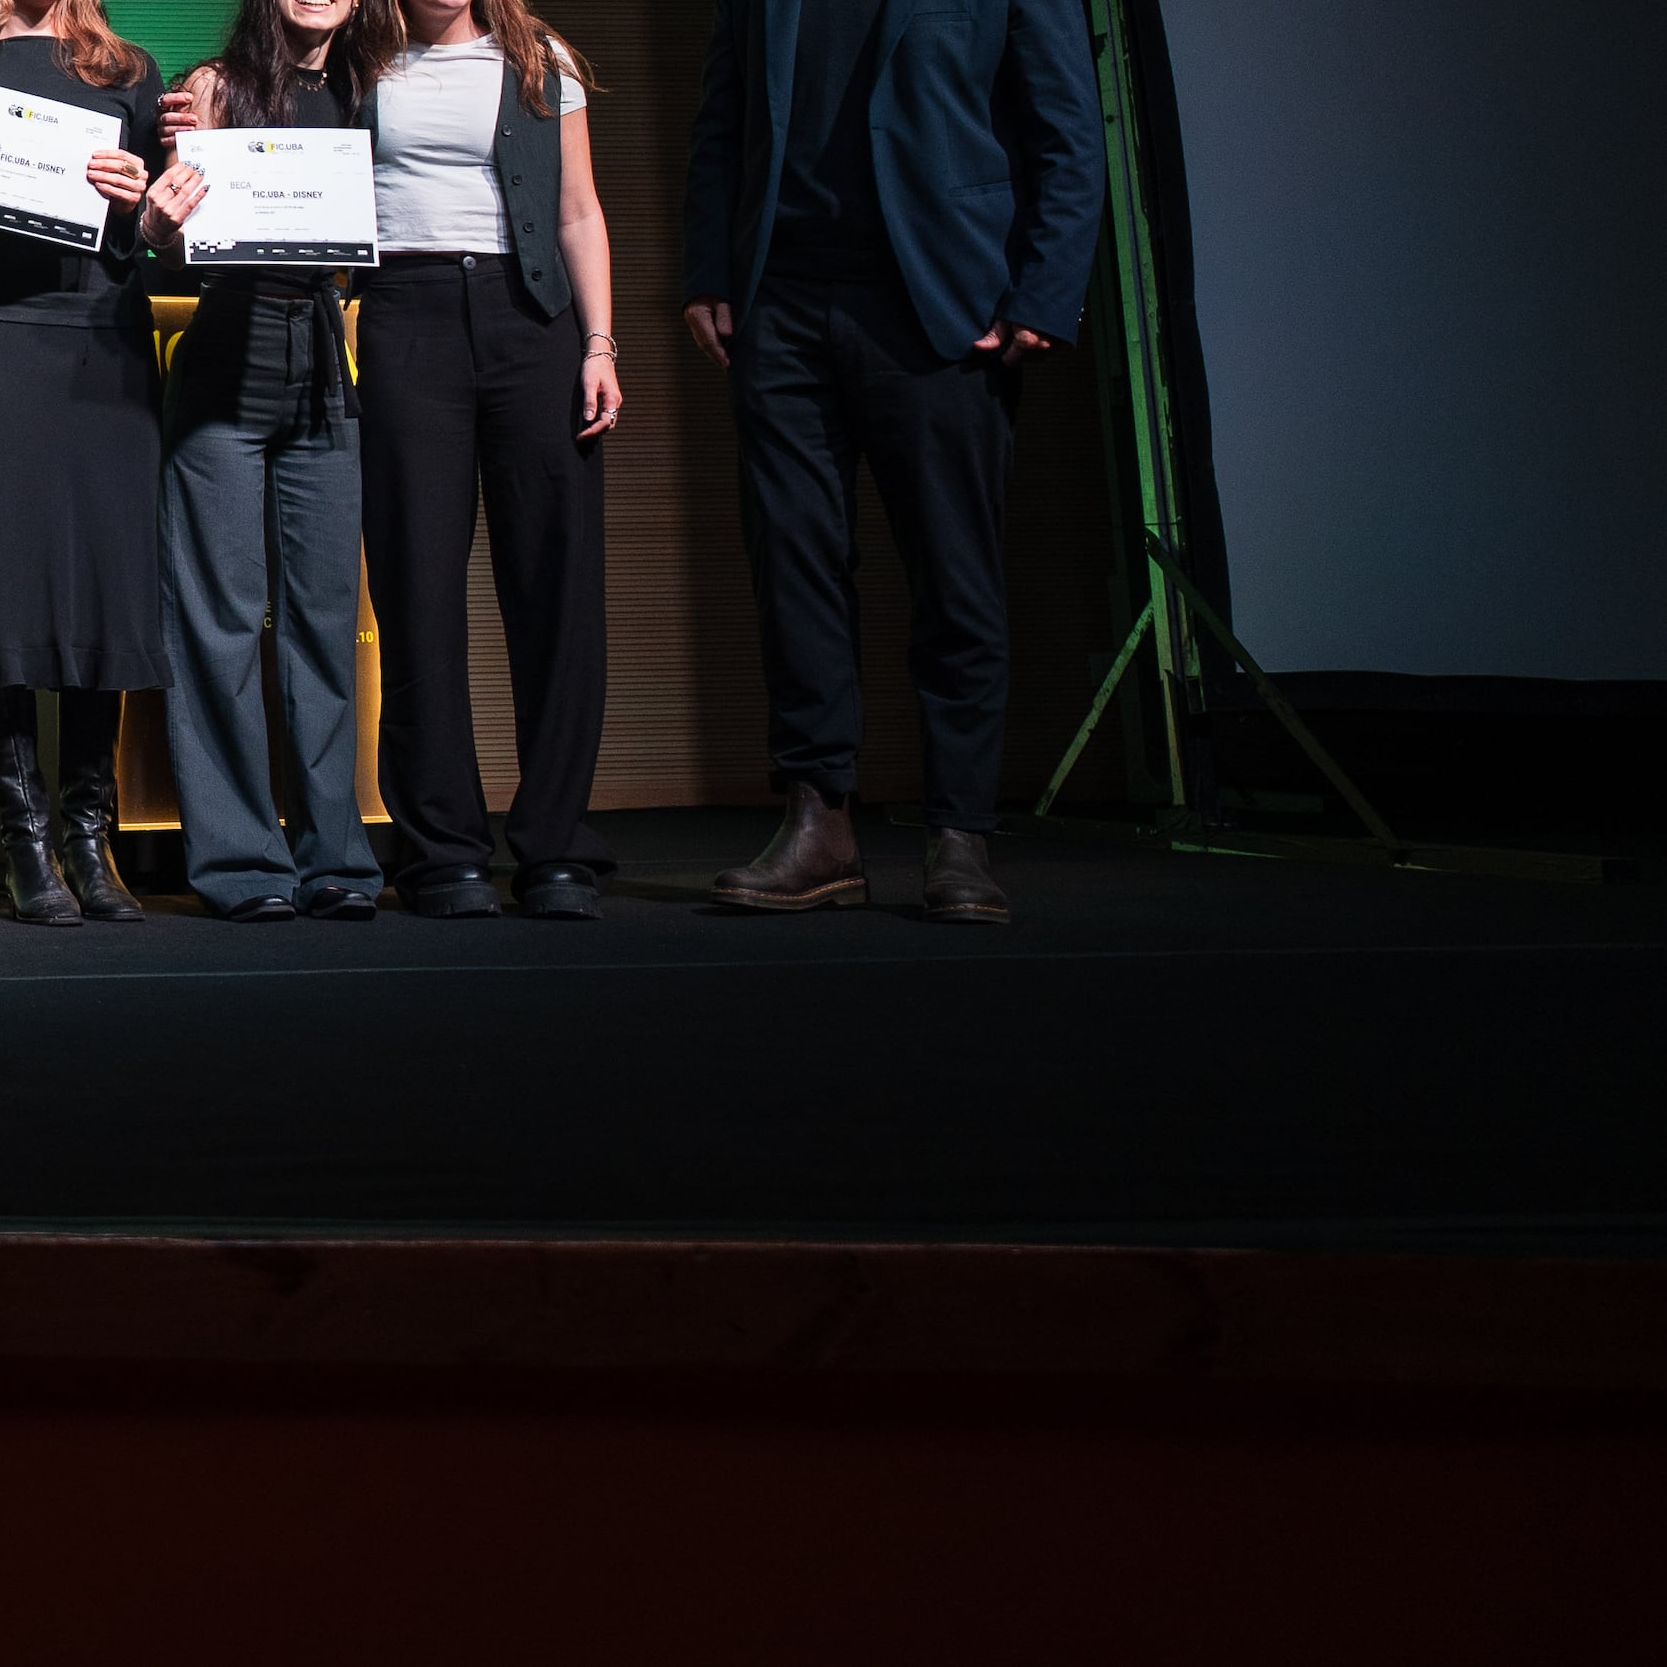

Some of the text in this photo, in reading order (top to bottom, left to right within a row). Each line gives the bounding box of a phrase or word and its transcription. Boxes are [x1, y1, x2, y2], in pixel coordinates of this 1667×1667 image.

[28, 110, 59, 125] FIC.UBA
[270, 143, 304, 151] FIC.UBA
[0, 153, 31, 168] FIC.UBA
[37, 161, 67, 176] DISNEY
[229, 181, 252, 190] BECA
[252, 191, 285, 199] FIC.UBA
[293, 191, 323, 199] DISNEY
